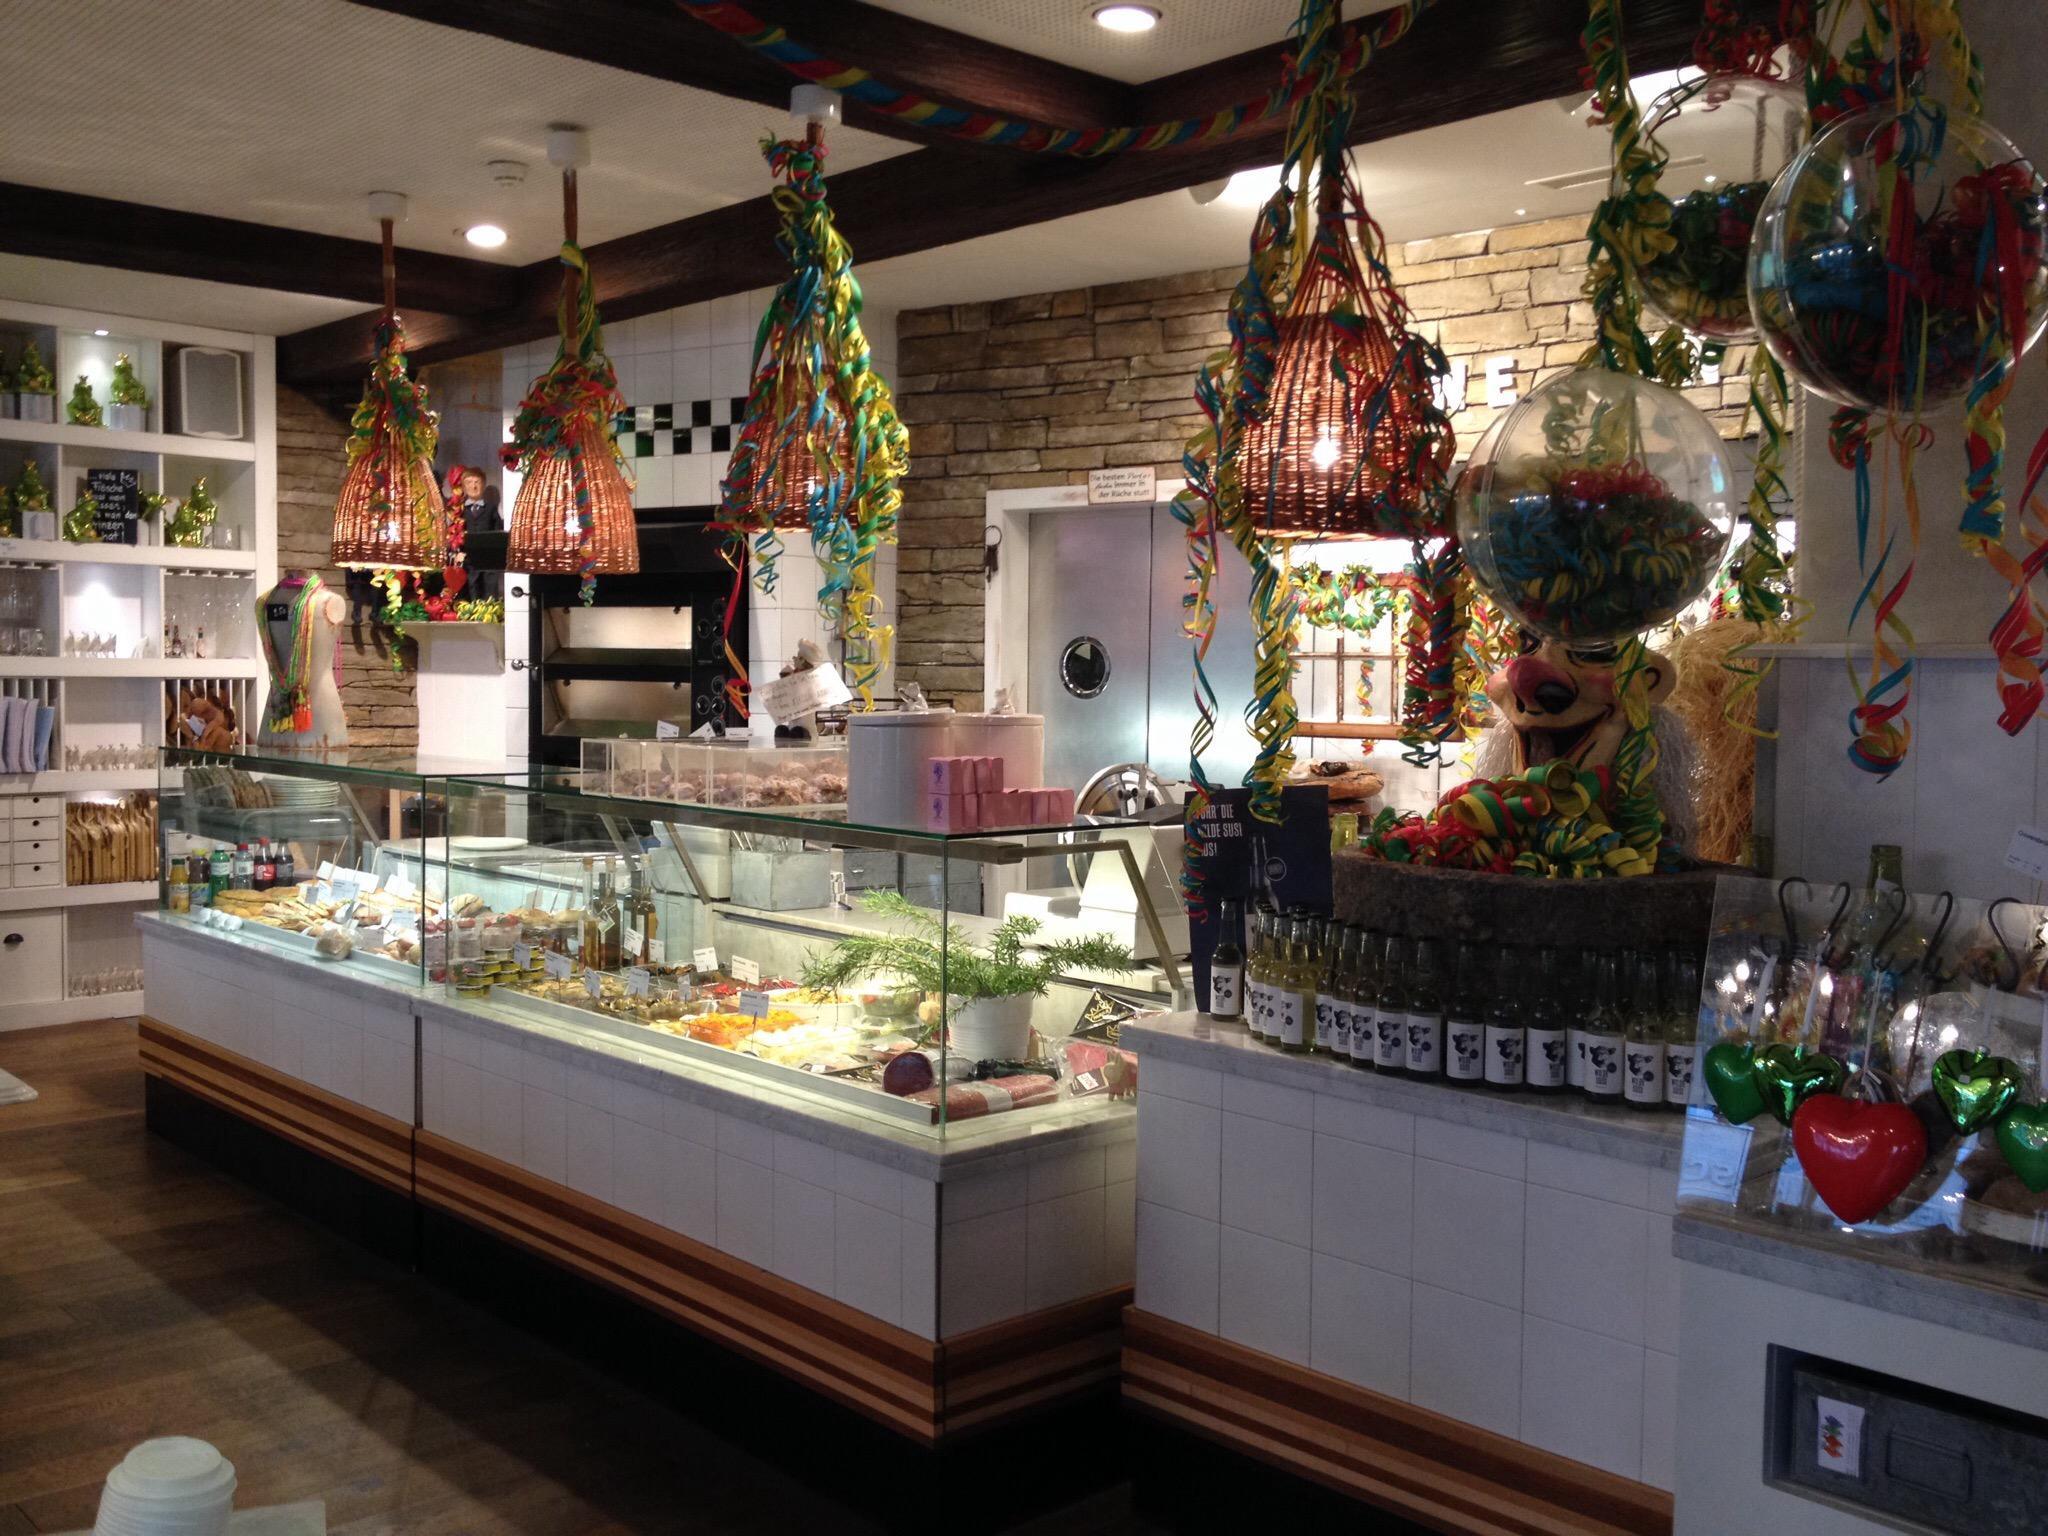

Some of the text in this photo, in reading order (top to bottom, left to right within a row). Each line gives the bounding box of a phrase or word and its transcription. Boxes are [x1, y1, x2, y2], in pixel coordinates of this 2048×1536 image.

[1103, 473, 1125, 481] besten
[1114, 480, 1136, 488] immer
[1221, 804, 1234, 819] DIE
[1223, 822, 1242, 837] SUSI
